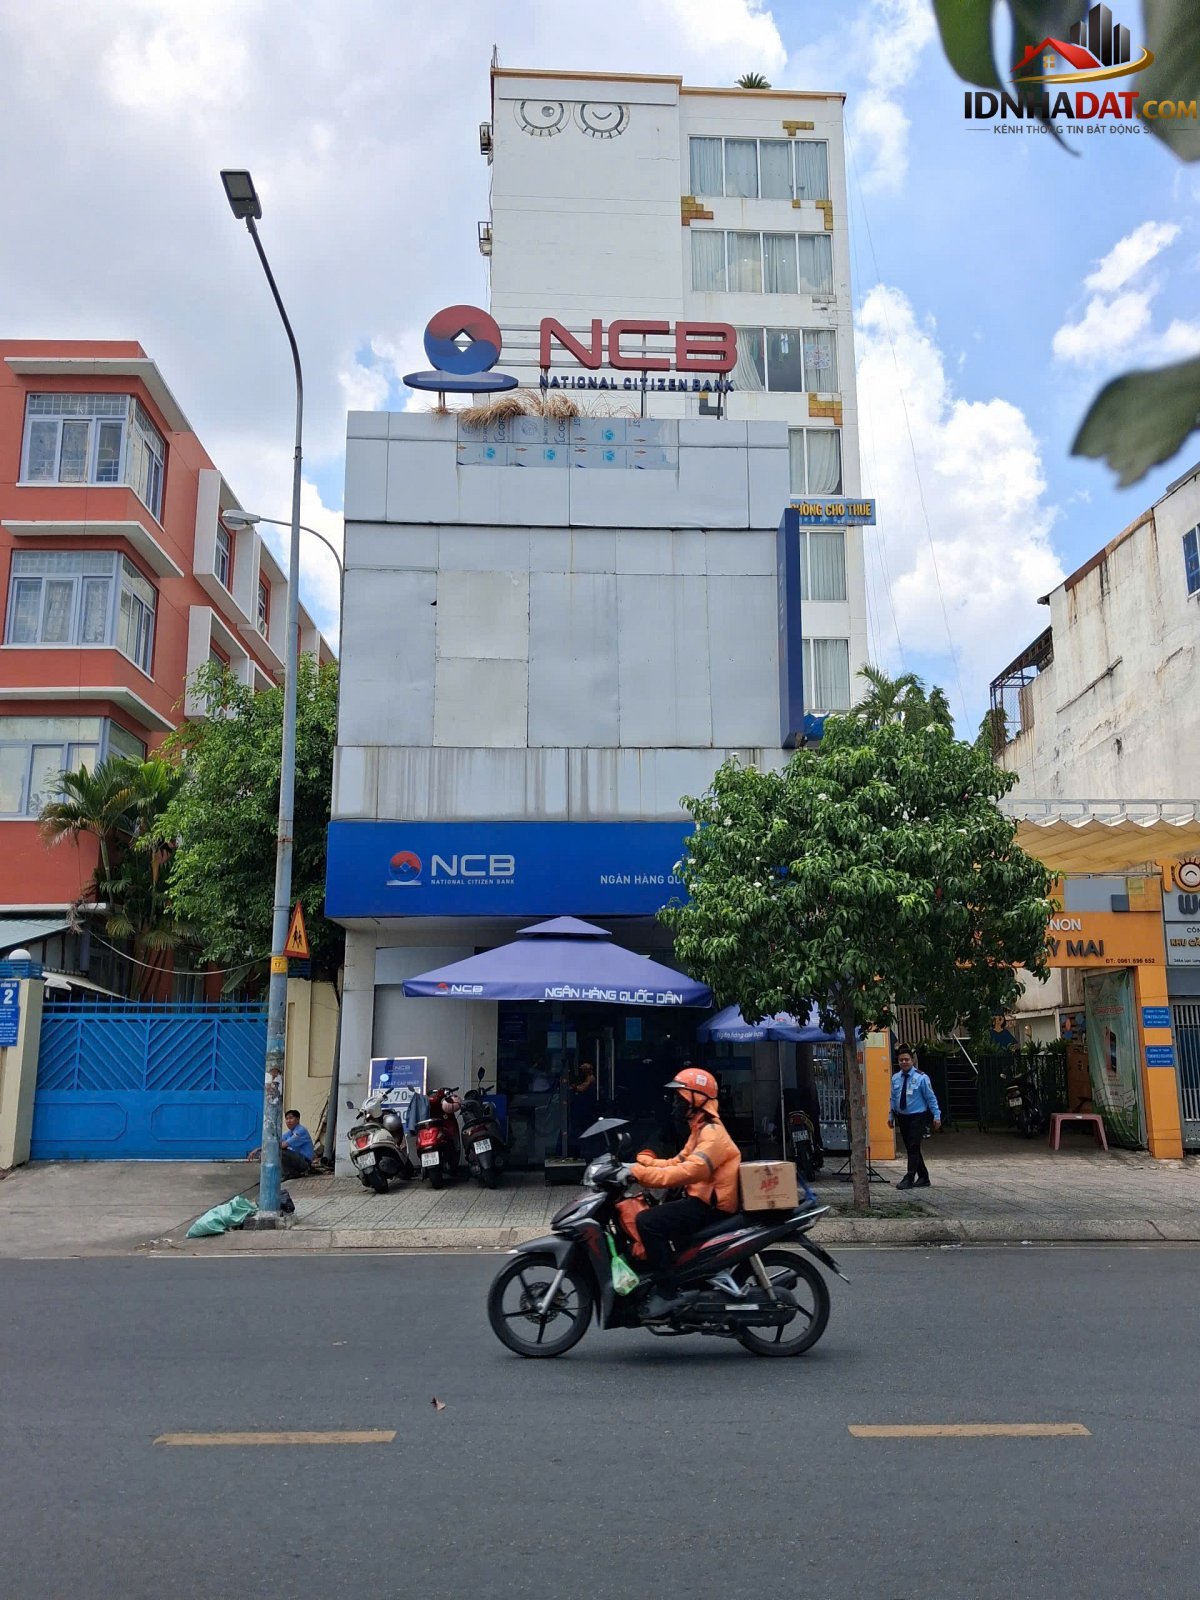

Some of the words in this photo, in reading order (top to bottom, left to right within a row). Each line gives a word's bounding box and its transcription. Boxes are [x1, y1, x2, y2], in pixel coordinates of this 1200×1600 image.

[540, 317, 737, 373] NCB
[540, 375, 617, 389] NATIONAL
[623, 378, 687, 391] CITIZEN
[692, 379, 735, 392] BANK
[825, 503, 845, 516] CHO
[847, 502, 872, 516] THUÊ
[431, 855, 515, 876] NCB
[600, 873, 630, 884] NGÂN
[634, 873, 664, 884] HÀNG
[1050, 918, 1082, 931] NON
[1066, 940, 1104, 957] MAI
[3, 988, 14, 1004] 2
[451, 984, 483, 993] NCB
[545, 986, 580, 998] NGÂN
[582, 986, 617, 1000] HÀNG
[620, 989, 654, 1003] QUỐC
[656, 990, 682, 1004] DÂN
